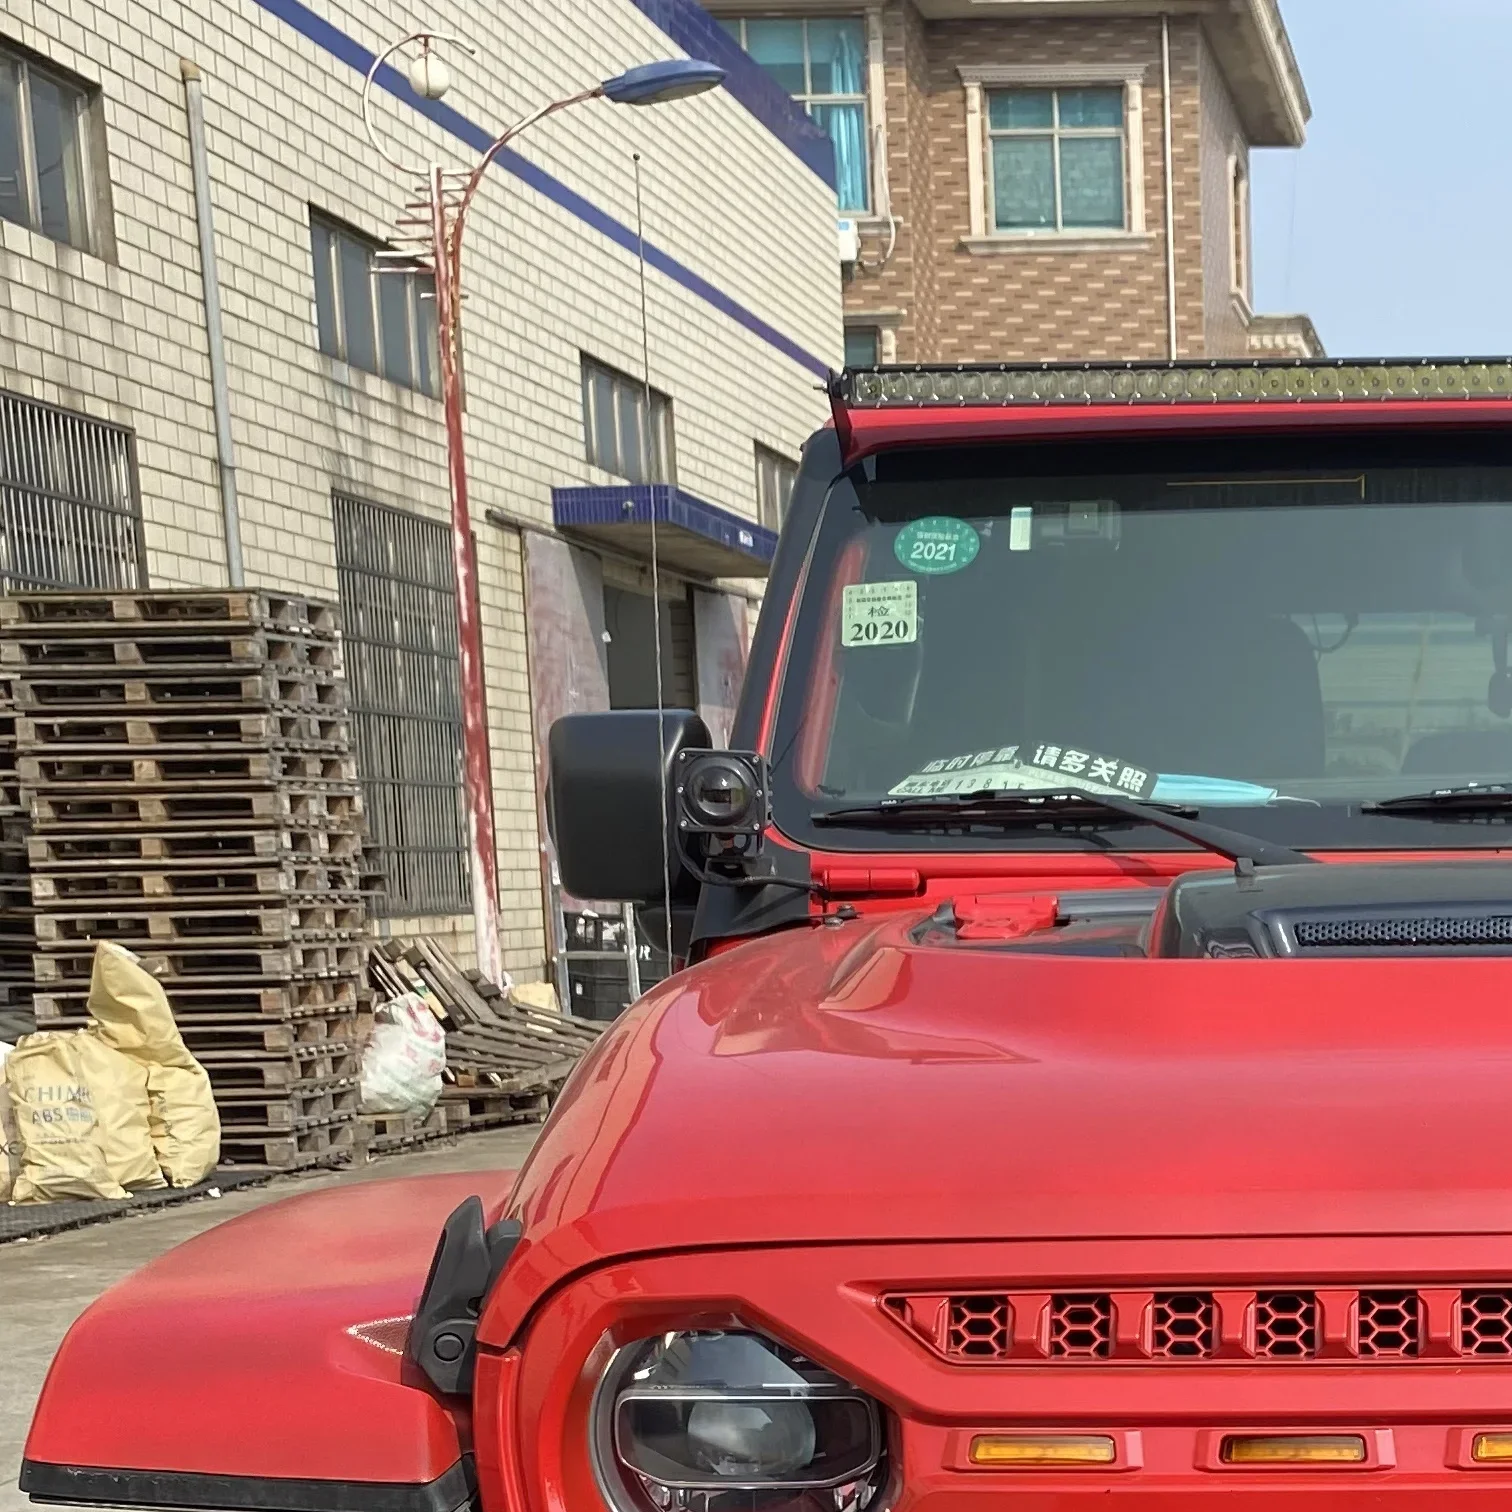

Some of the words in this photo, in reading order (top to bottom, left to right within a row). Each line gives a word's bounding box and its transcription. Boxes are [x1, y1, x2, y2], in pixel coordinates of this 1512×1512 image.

[910, 541, 957, 561] 2021
[850, 620, 909, 642] 2020
[1033, 745, 1149, 793] 请多关照
[32, 1107, 63, 1124] ABS
